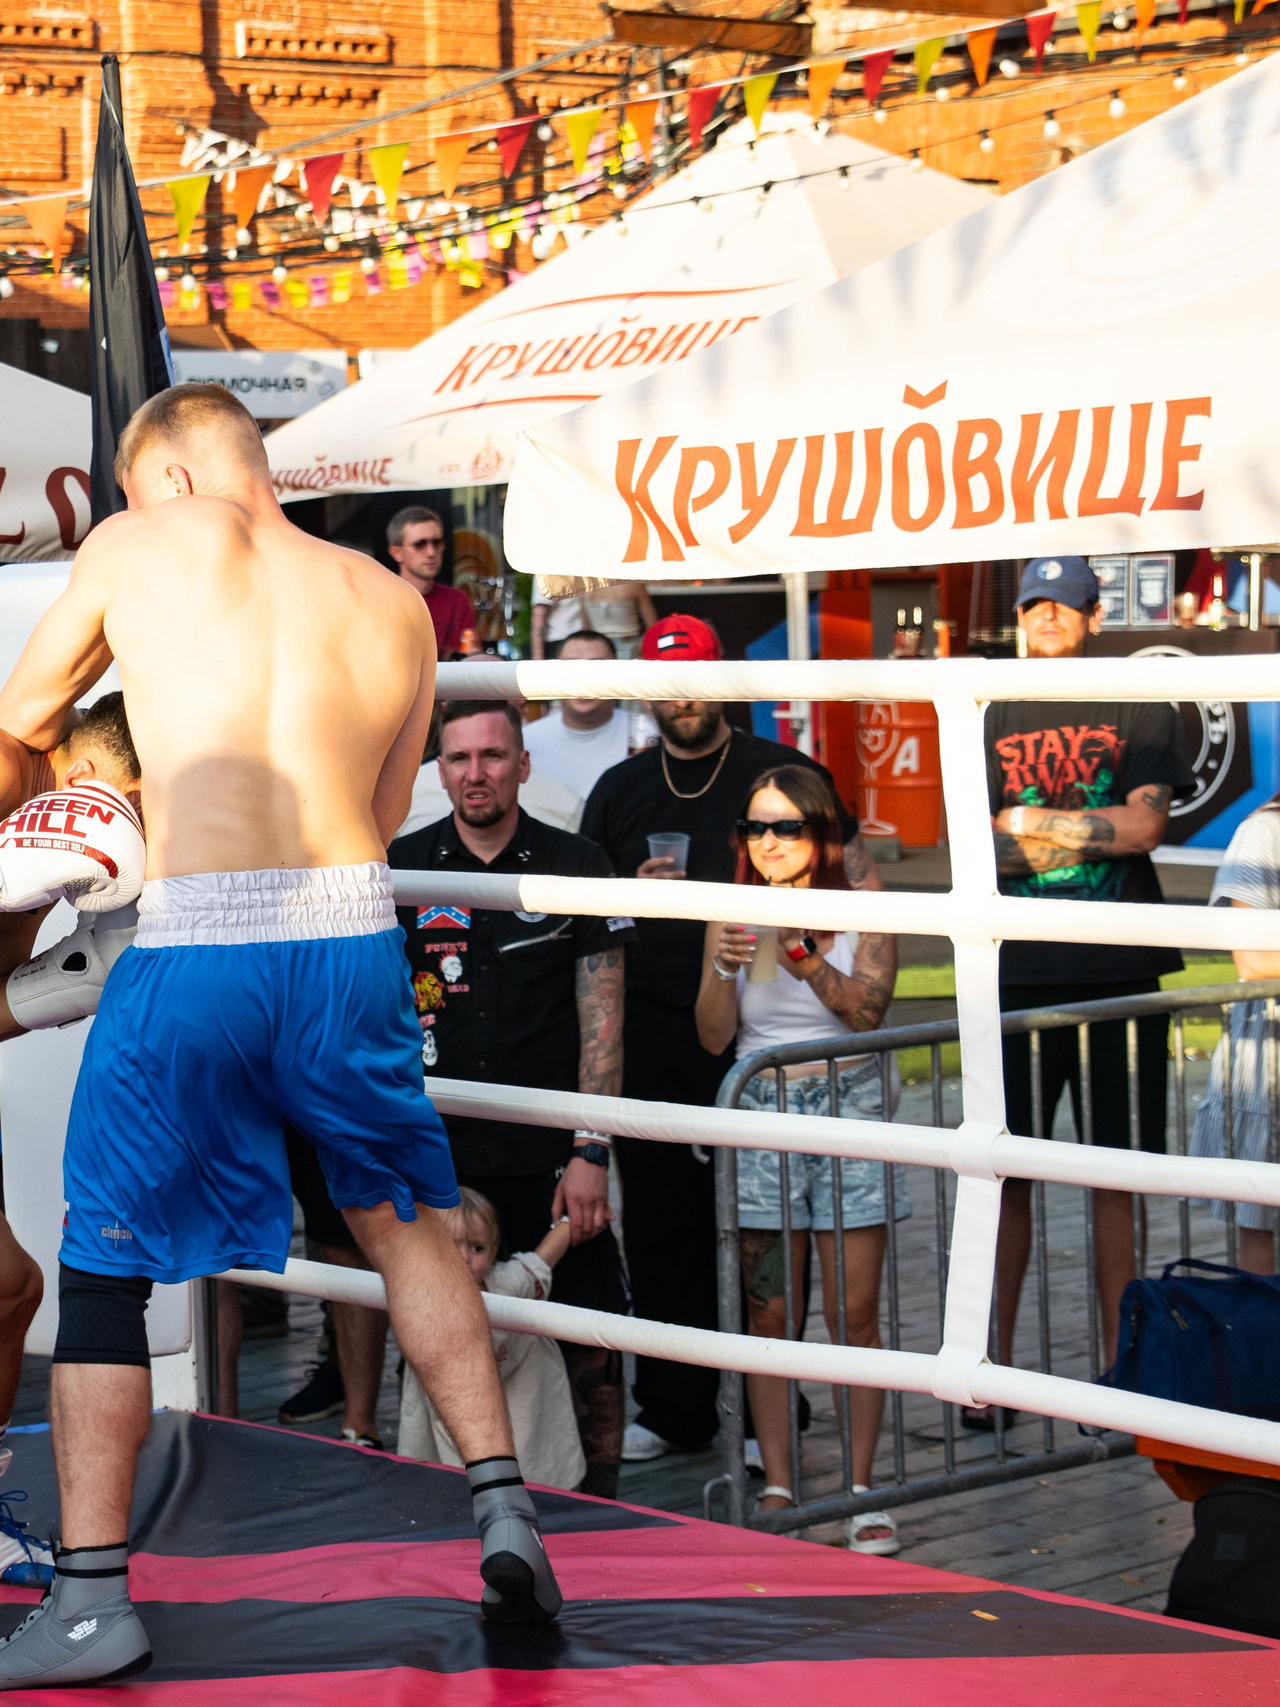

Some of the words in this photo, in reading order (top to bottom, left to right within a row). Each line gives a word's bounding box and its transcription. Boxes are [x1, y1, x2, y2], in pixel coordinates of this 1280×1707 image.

[995, 725, 1090, 771] STAY
[22, 839, 32, 847] BE
[33, 839, 52, 848] YOUR
[53, 840, 70, 850] BEST
[71, 843, 86, 853] SELF
